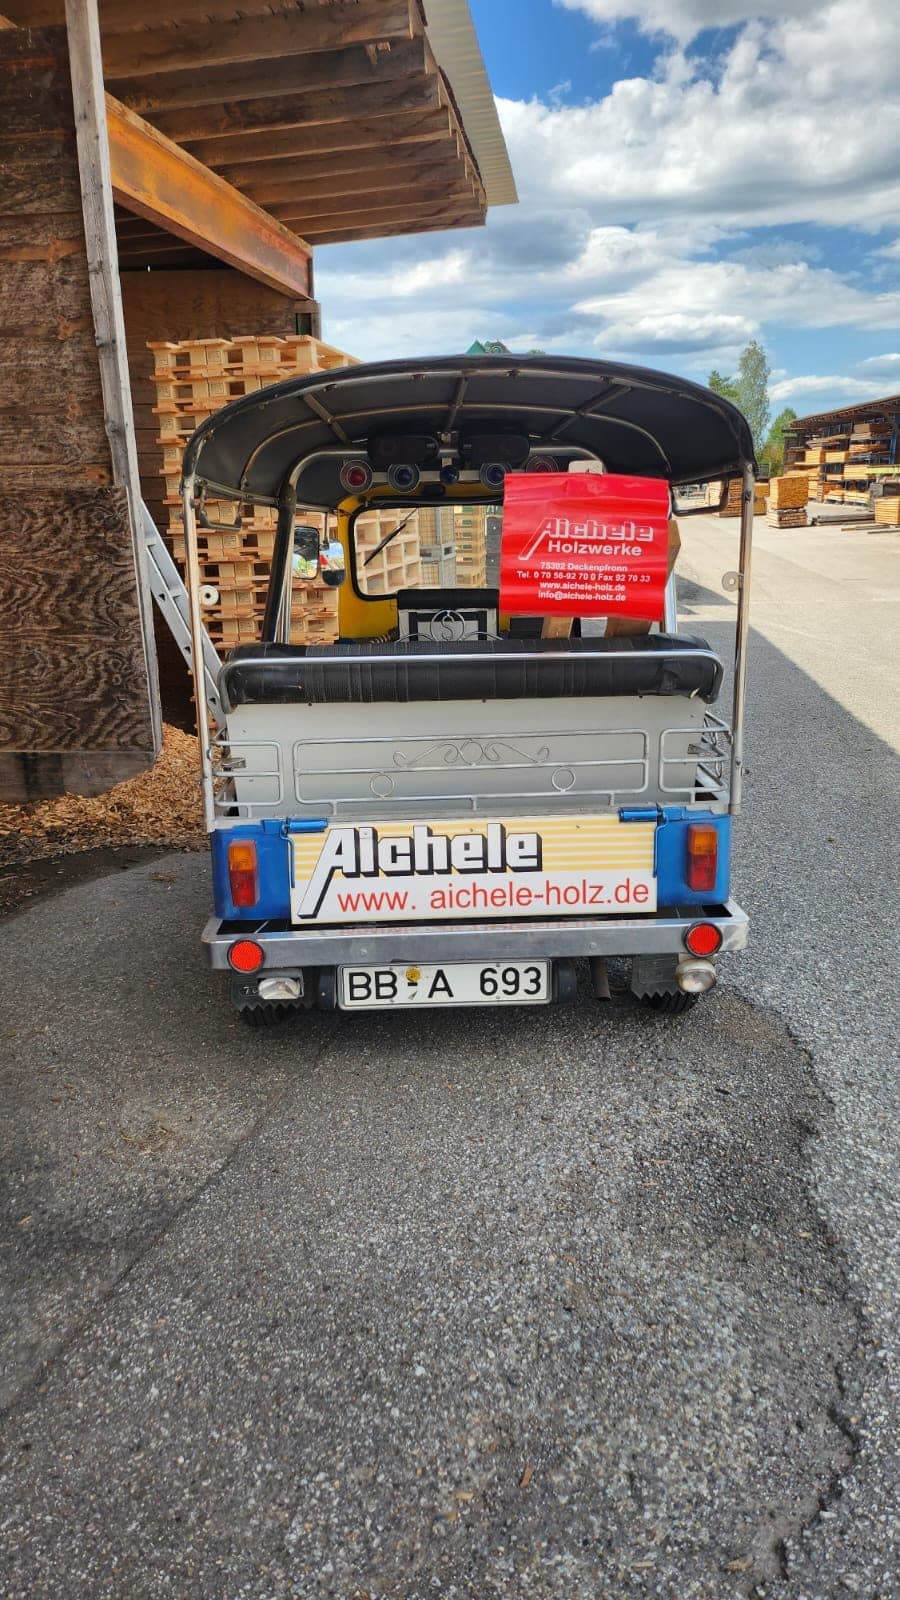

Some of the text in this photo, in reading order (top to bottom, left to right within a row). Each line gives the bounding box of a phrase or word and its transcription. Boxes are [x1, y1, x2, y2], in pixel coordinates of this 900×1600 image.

[518, 517, 654, 560] Aichele
[548, 541, 642, 556] Holzwerke
[567, 563, 628, 573] Deckenpfronn
[598, 573, 613, 581] Fax
[539, 581, 626, 591] www.aichele-holz.de
[538, 590, 627, 601] info@aichele-holz.de
[297, 822, 543, 919] Aichele
[430, 878, 650, 909] aichele-holz.de
[479, 966, 543, 997] 693
